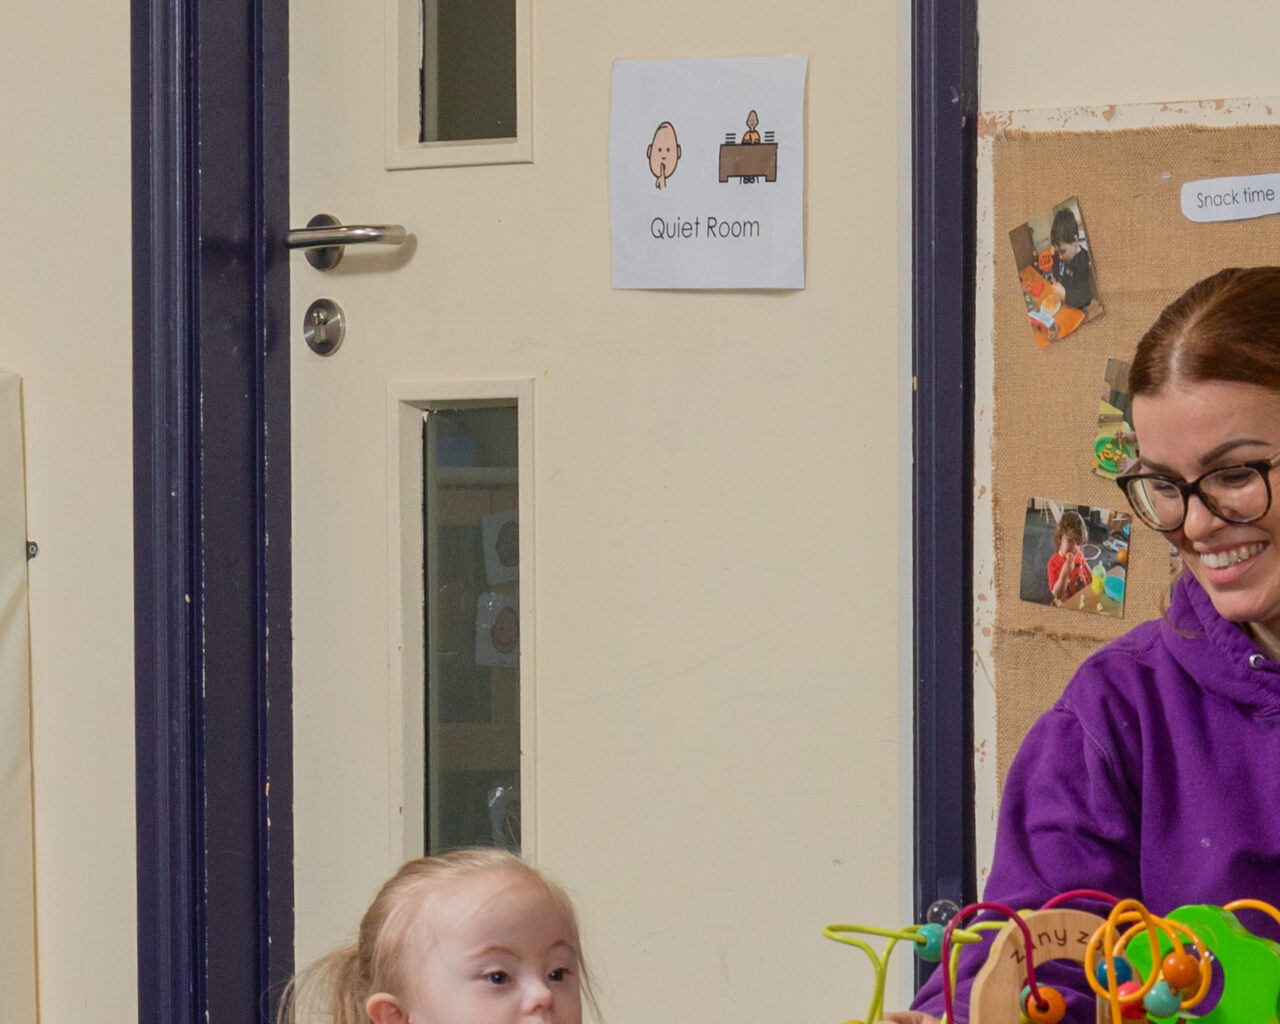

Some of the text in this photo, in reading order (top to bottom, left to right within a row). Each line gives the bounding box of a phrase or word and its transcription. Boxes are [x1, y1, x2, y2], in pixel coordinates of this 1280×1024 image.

[1197, 187, 1275, 208] Snack time
[650, 216, 760, 240] Quiet Room
[1011, 929, 1067, 963] zny
